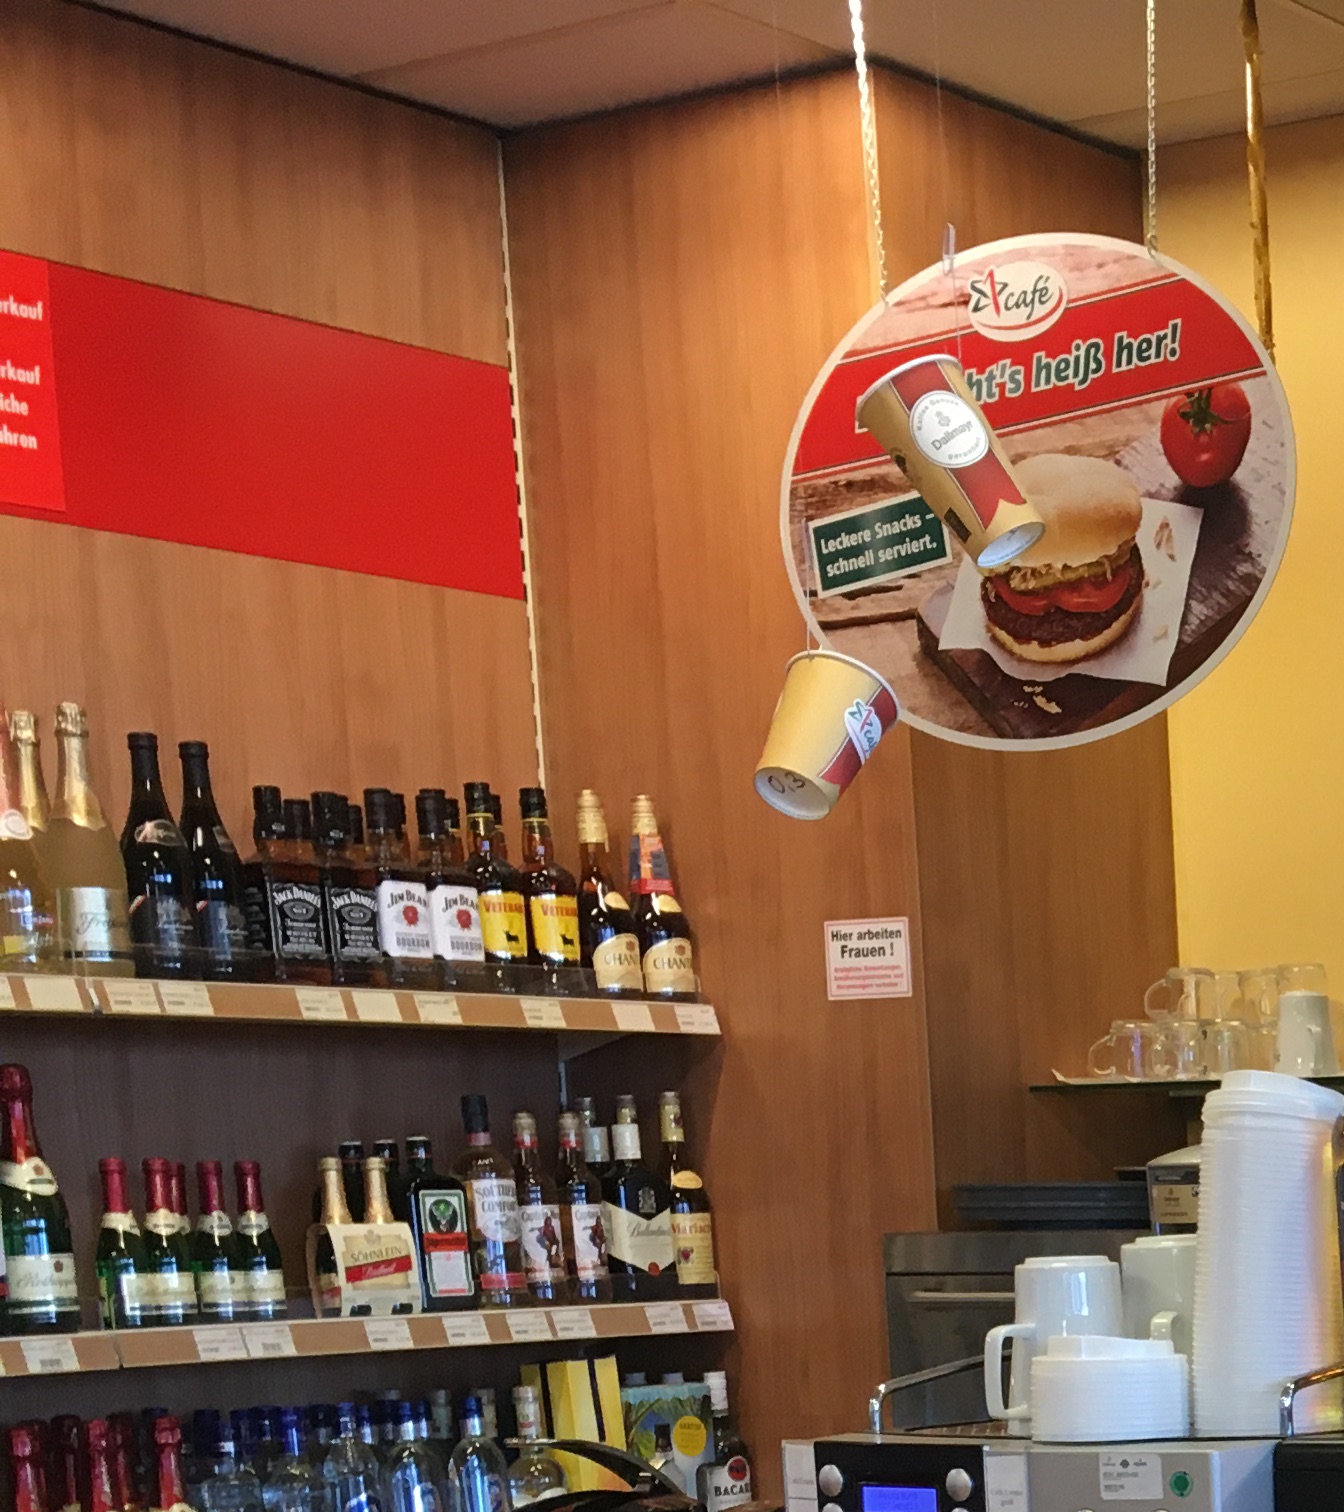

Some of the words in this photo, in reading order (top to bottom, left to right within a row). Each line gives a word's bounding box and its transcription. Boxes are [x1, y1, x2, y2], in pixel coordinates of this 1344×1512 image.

[0, 294, 43, 321] rkauf
[1004, 274, 1053, 320] café
[0, 359, 41, 385] rkauf
[966, 361, 1023, 402] ht's
[1032, 341, 1104, 389] heiß
[1114, 321, 1180, 374] her!
[931, 420, 973, 451] Dallmayr
[820, 531, 871, 555] Leckere
[874, 514, 922, 539] Snacks
[826, 549, 875, 577] schnell
[878, 534, 937, 563] serviert.
[387, 892, 405, 908] JIM
[442, 896, 458, 912] JIM
[831, 930, 853, 942] Hier
[857, 928, 902, 940] arbeiten
[840, 945, 886, 959] Frauen
[714, 1483, 751, 1497] BACAR
